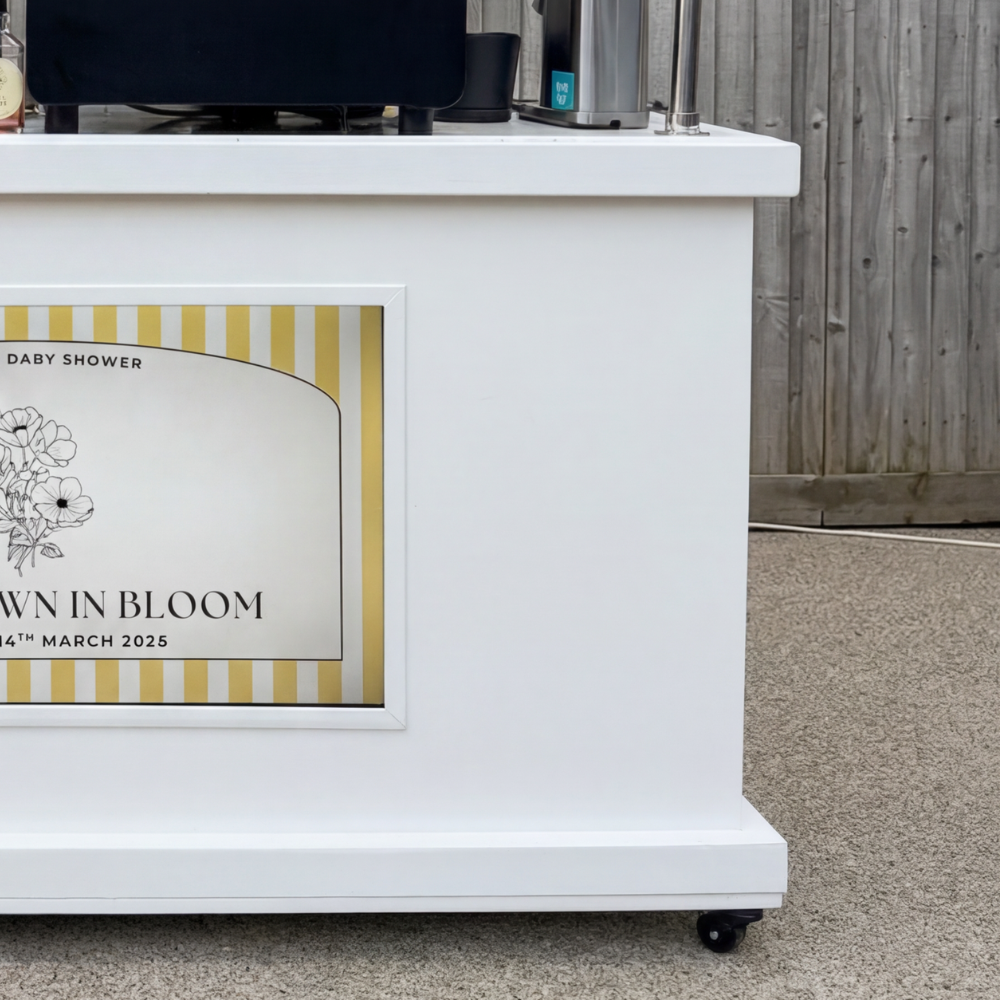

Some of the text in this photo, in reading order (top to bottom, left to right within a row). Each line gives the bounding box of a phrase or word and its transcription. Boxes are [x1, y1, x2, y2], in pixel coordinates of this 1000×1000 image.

[62, 353, 142, 370] SHOWER
[71, 590, 107, 619] IN
[118, 590, 263, 620] BLOOM
[42, 634, 113, 648] MARCH
[121, 634, 168, 648] 2025
